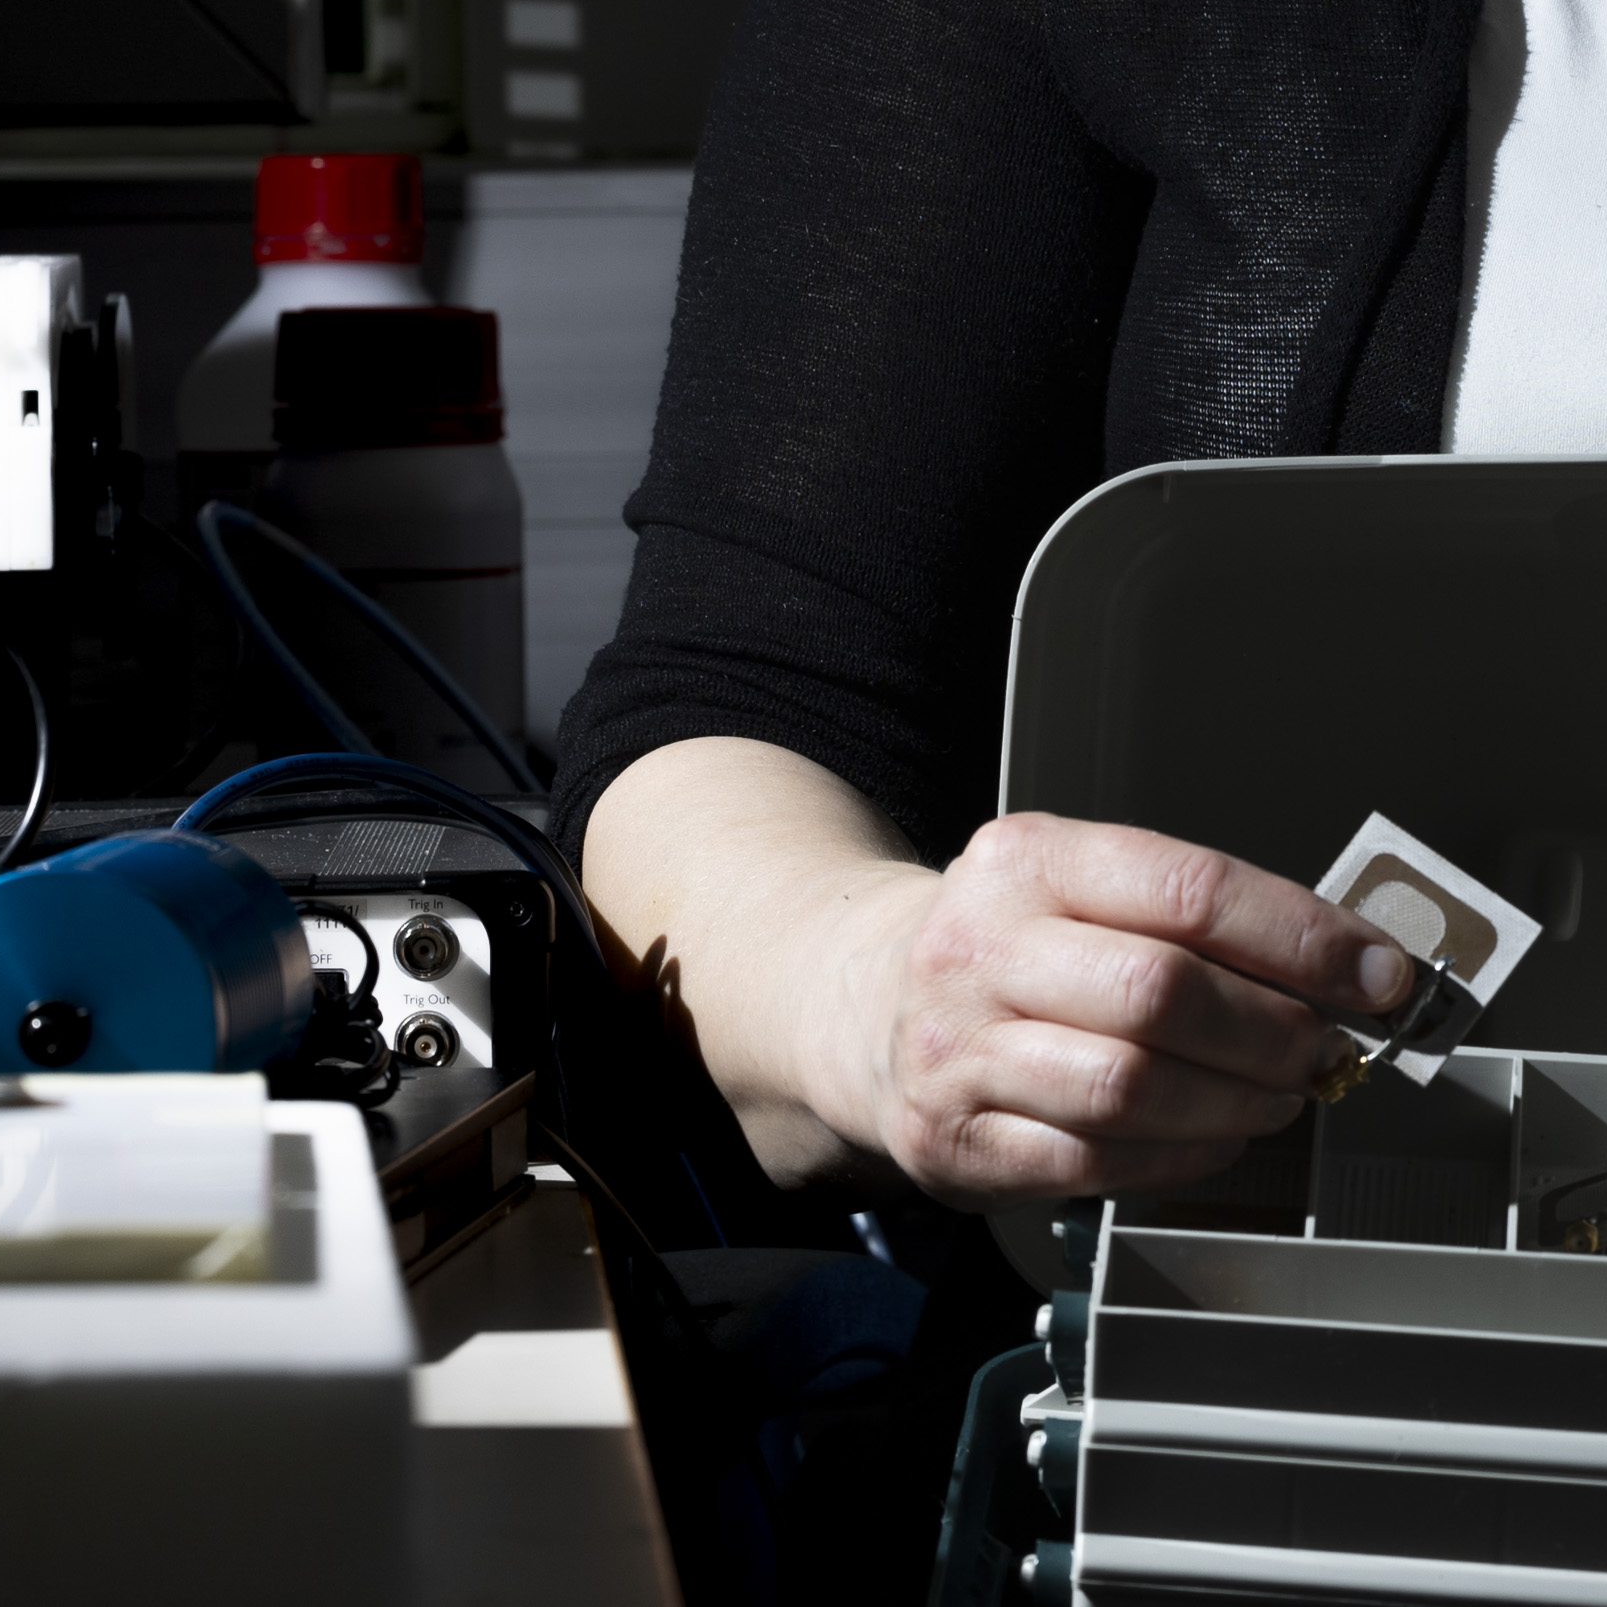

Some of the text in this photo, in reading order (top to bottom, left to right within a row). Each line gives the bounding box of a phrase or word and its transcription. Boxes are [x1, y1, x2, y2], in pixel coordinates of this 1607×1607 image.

[408, 898, 444, 912] Trig In
[310, 953, 333, 965] OFF
[403, 993, 451, 1008] Trig Out
